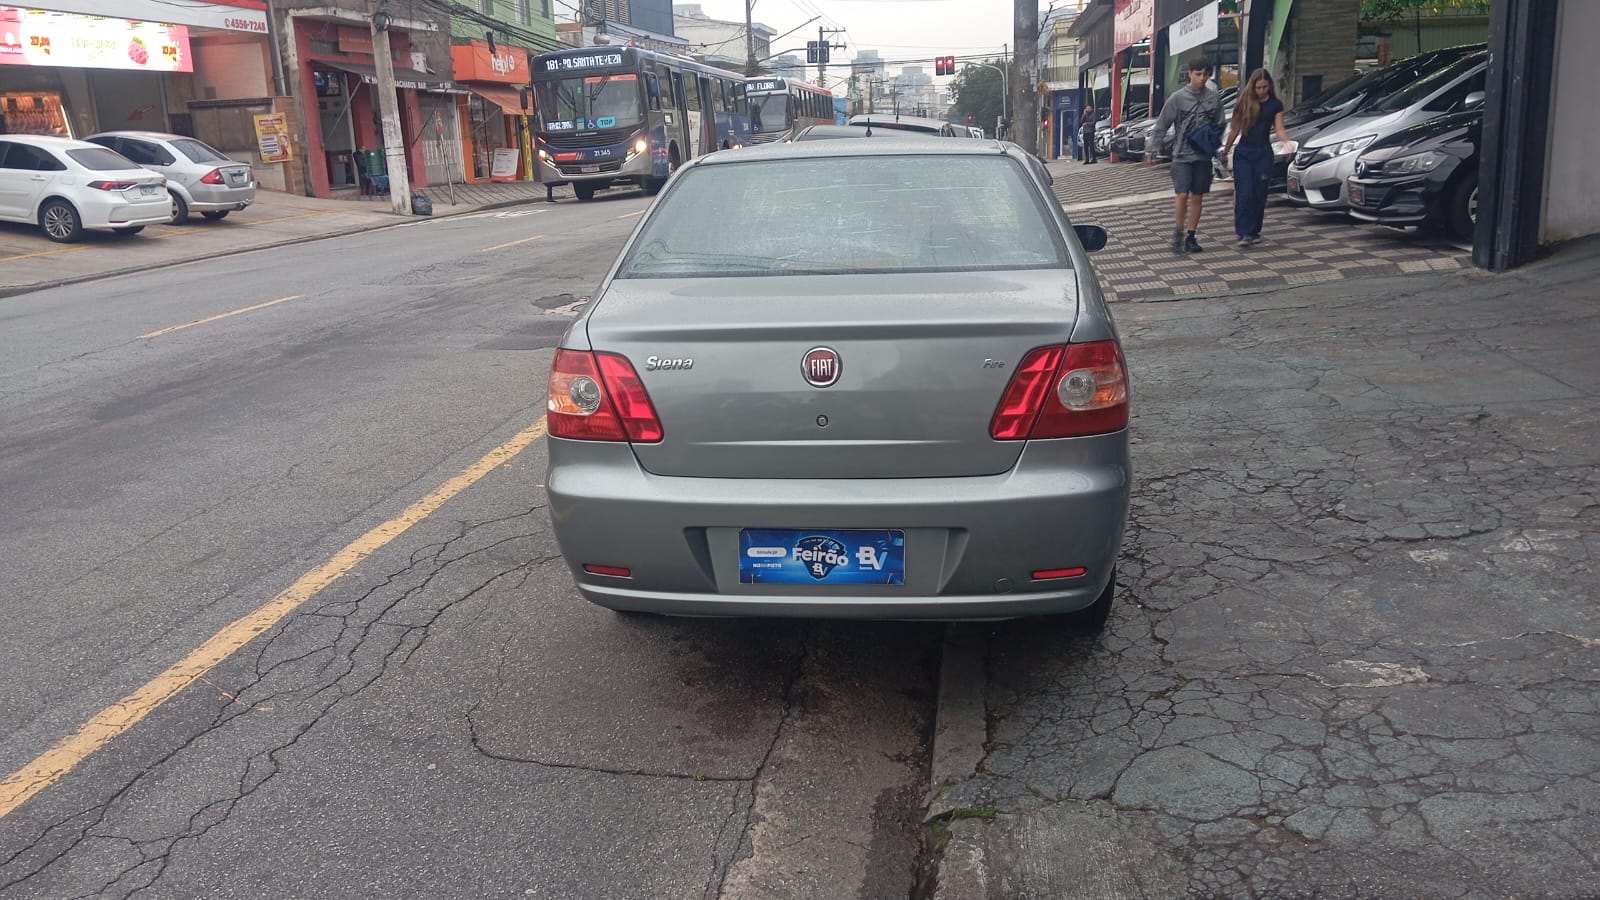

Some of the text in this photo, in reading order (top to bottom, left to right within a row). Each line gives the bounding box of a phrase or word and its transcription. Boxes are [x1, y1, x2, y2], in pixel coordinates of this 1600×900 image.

[645, 355, 694, 371] Siena
[811, 358, 833, 377] FIAT
[792, 546, 849, 567] Feirão
[855, 546, 888, 570] BV
